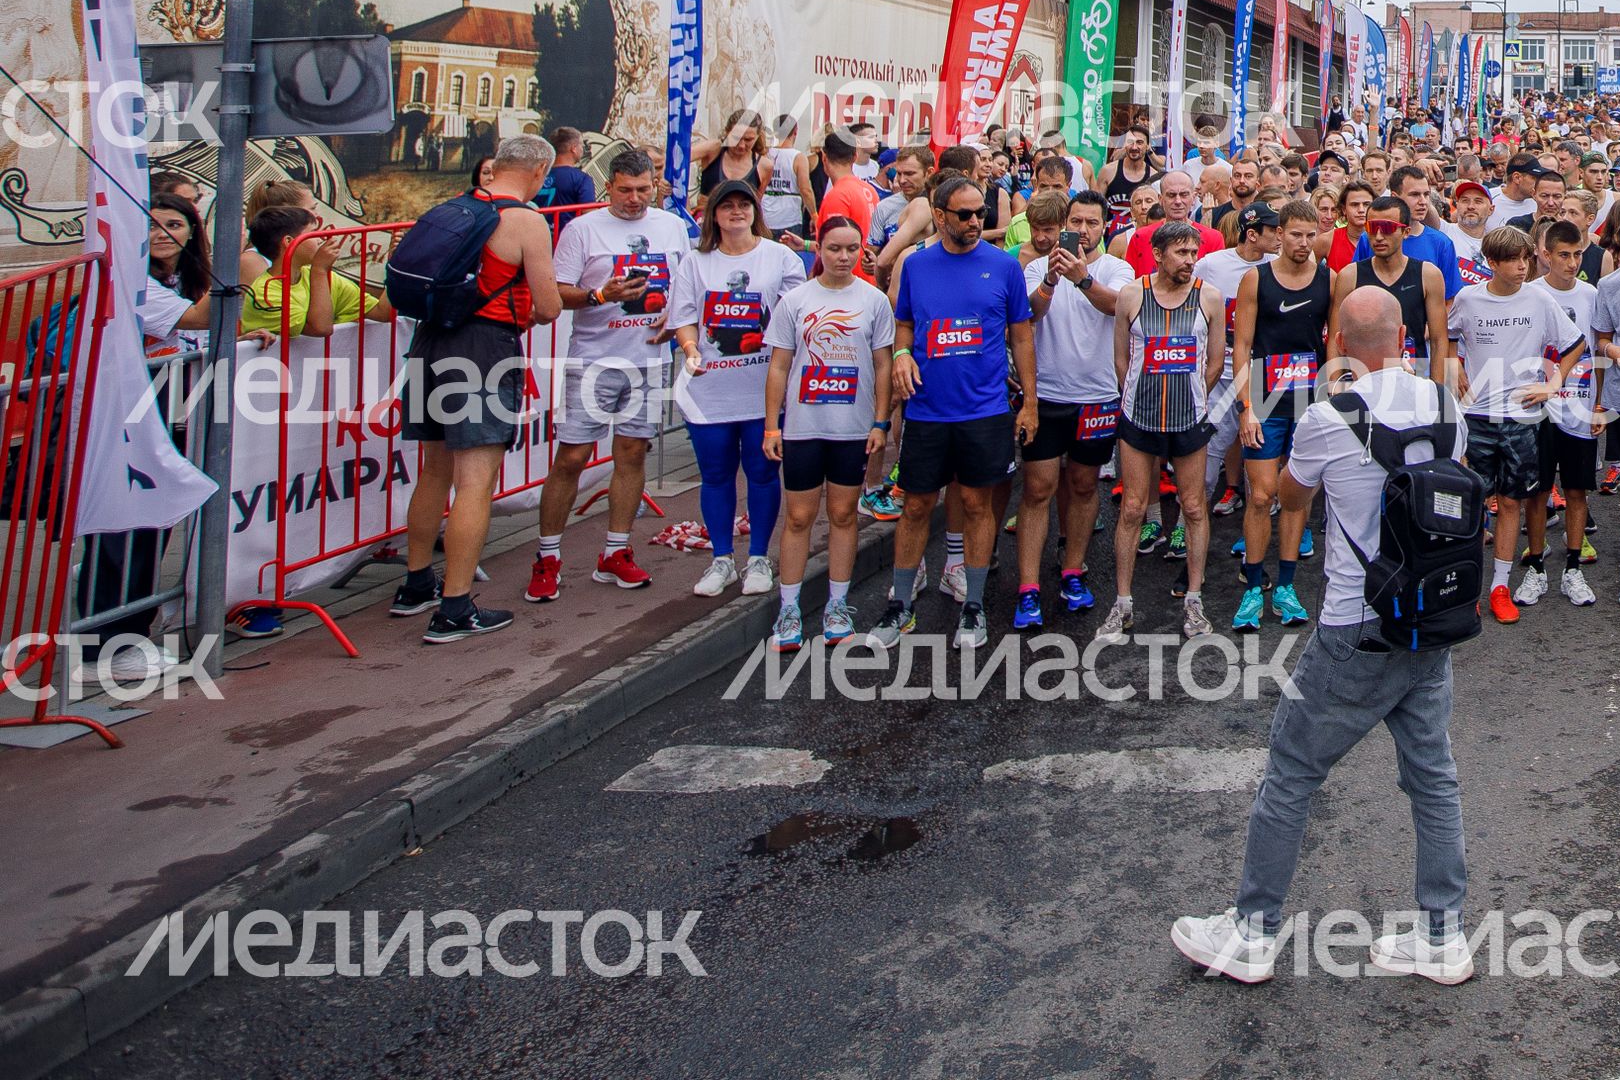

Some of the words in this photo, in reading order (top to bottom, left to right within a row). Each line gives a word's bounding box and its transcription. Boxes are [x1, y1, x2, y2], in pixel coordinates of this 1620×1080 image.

[713, 304, 750, 316] 9167
[608, 316, 661, 329] #БОКСЗА
[1478, 319, 1483, 327] 2
[1486, 318, 1510, 327] HAVE
[1512, 317, 1531, 326] FUN
[937, 331, 972, 345] 8316
[1153, 349, 1187, 361] 8163
[706, 356, 771, 370] #БОКСЗАБЕ
[1274, 366, 1310, 379] 7849
[808, 380, 849, 392] 9420
[1085, 414, 1116, 429] 10712
[232, 449, 411, 534] УМАРА
